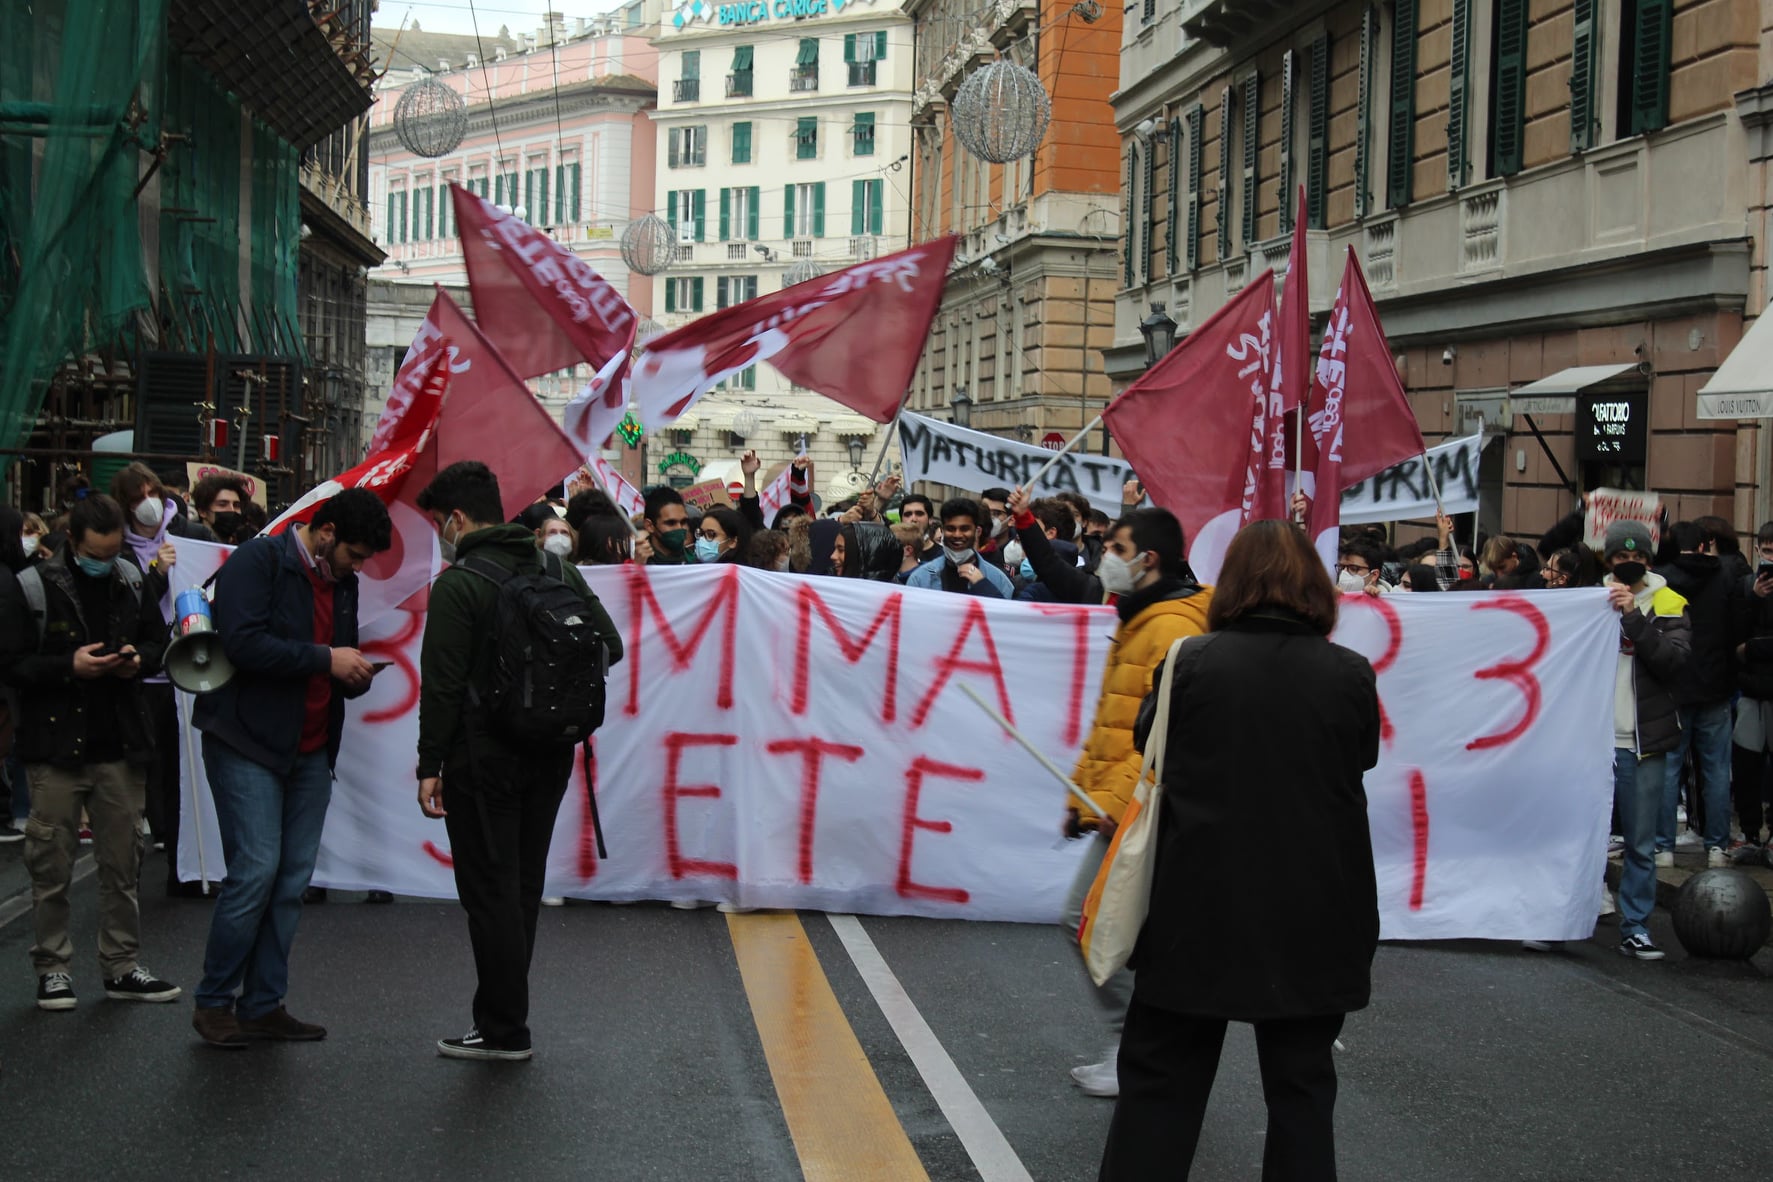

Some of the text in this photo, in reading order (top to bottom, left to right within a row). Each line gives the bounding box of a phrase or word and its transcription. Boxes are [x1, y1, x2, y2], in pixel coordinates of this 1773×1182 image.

[719, 0, 828, 25] BANCA CARIGE
[1717, 399, 1761, 414] LOUIS VUITTON
[1041, 440, 1066, 450] STOP
